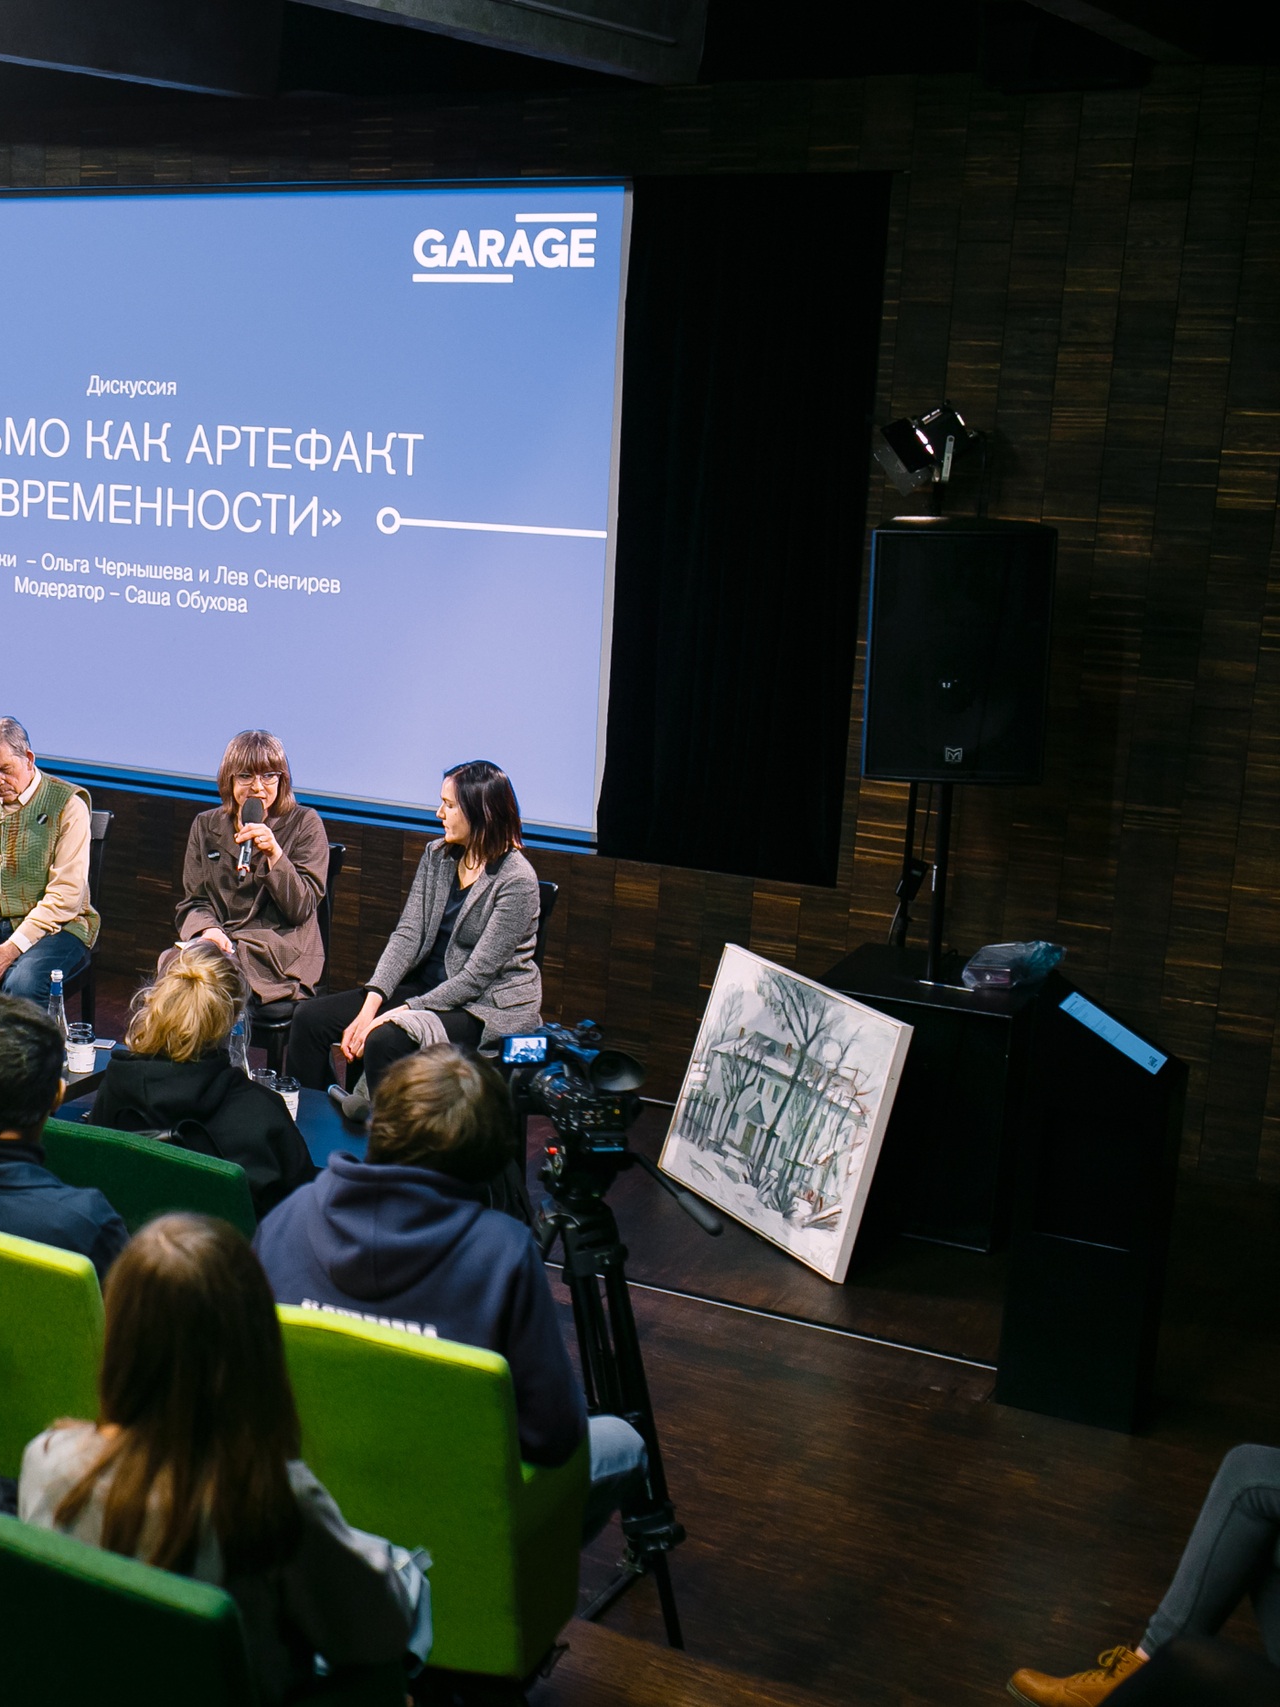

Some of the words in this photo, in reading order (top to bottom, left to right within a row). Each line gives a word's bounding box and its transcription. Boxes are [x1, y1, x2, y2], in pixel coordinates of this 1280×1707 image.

[412, 227, 597, 268] GARAGE
[86, 374, 177, 398] Дискуссия
[86, 419, 172, 463] КАК
[185, 424, 425, 476] АРТЕФАКТ
[14, 575, 105, 603] Модератор
[125, 584, 171, 606] Саша
[176, 588, 248, 613] Обухова
[41, 553, 90, 574] Ольга
[94, 557, 194, 582] Чернышева
[198, 568, 210, 583] и
[214, 566, 249, 586] Лев
[253, 569, 341, 595] Снегирев
